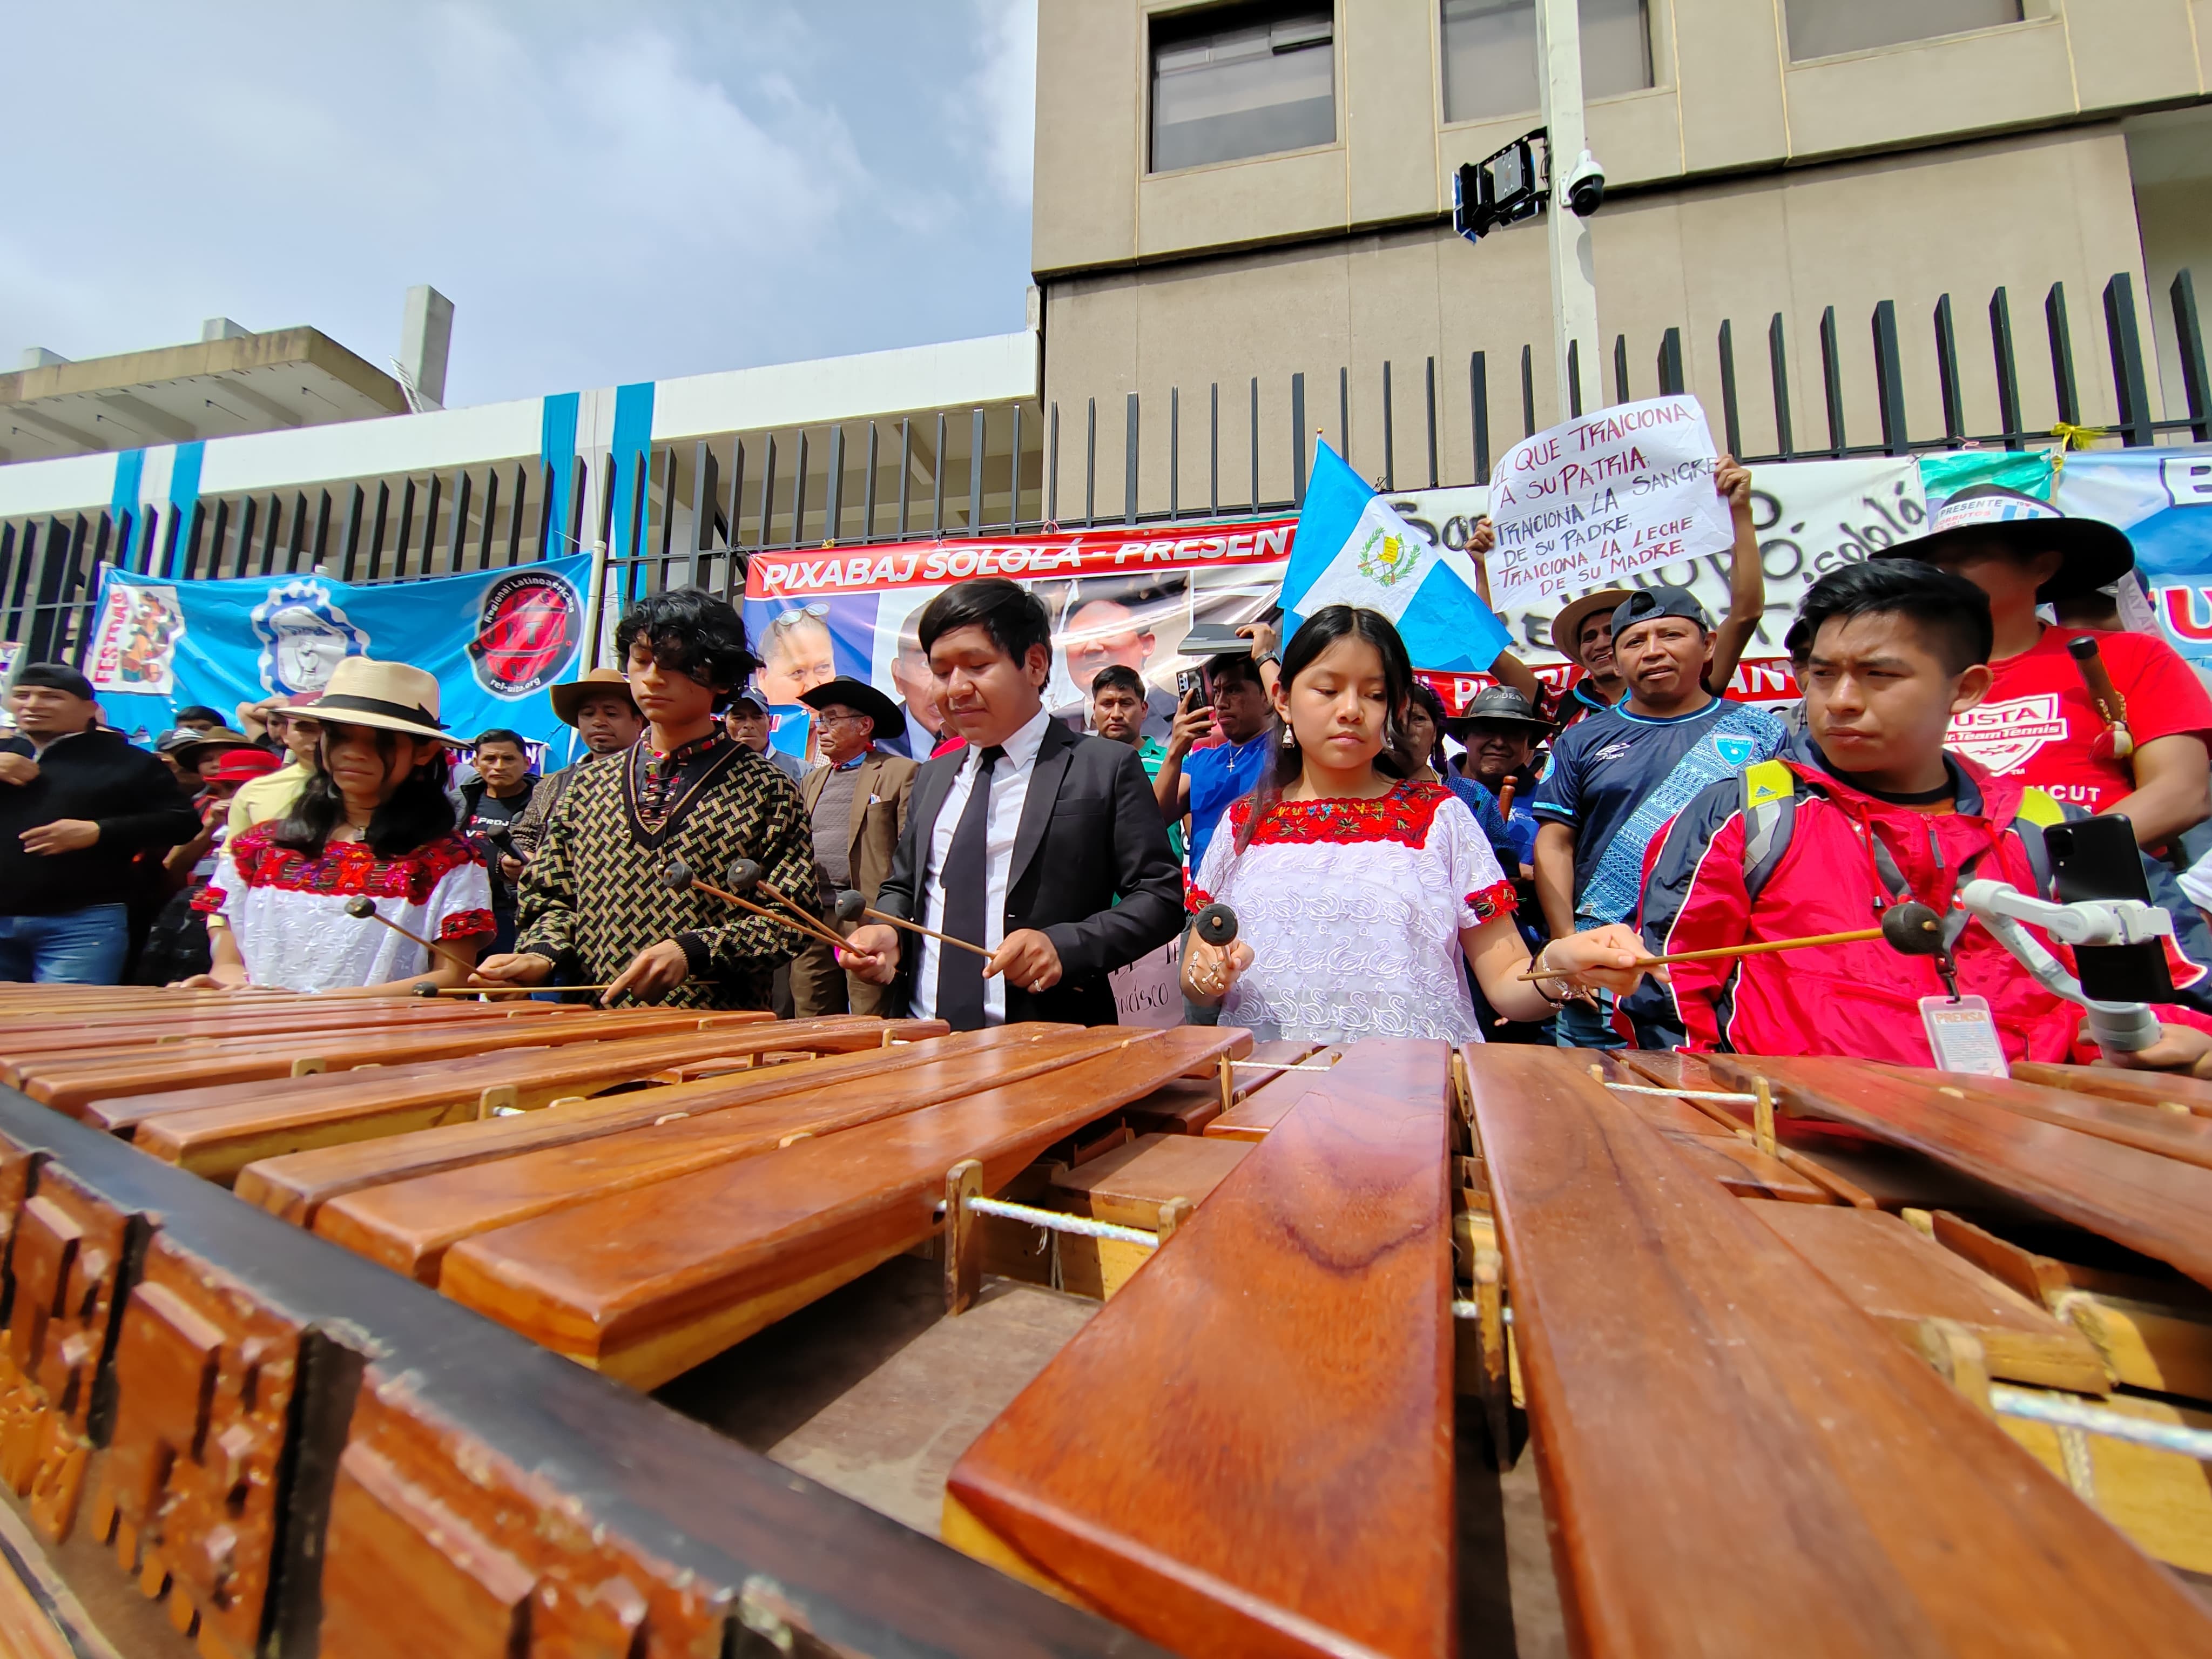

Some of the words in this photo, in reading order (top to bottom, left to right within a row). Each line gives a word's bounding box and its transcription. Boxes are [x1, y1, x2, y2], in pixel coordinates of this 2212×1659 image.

[1515, 438, 1561, 472] QUE
[1568, 403, 1695, 451] TRAICIONA
[1494, 504, 1586, 547] TRAICIONA
[1591, 487, 1619, 514] LA
[1633, 457, 1718, 496] SANGRE
[1500, 485, 1516, 509] A
[1526, 478, 1556, 500] SU
[1559, 447, 1651, 495] PATRIA,
[1940, 500, 2002, 517] PRESENTE
[763, 554, 920, 591] PIXABAJ
[922, 537, 1083, 579] SOLOLÁ
[1115, 526, 1296, 564] PRESEN
[1504, 548, 1528, 567] DE
[1536, 541, 1555, 556] SU
[1600, 539, 1622, 559] LA
[1633, 516, 1694, 549] LECHE
[1540, 577, 1566, 597] DE
[1578, 565, 1601, 582] SU
[1610, 539, 1685, 575] MADRE.
[1954, 707, 2040, 726] USTA
[1955, 730, 2001, 741] Team
[2000, 725, 2060, 738] Tennis
